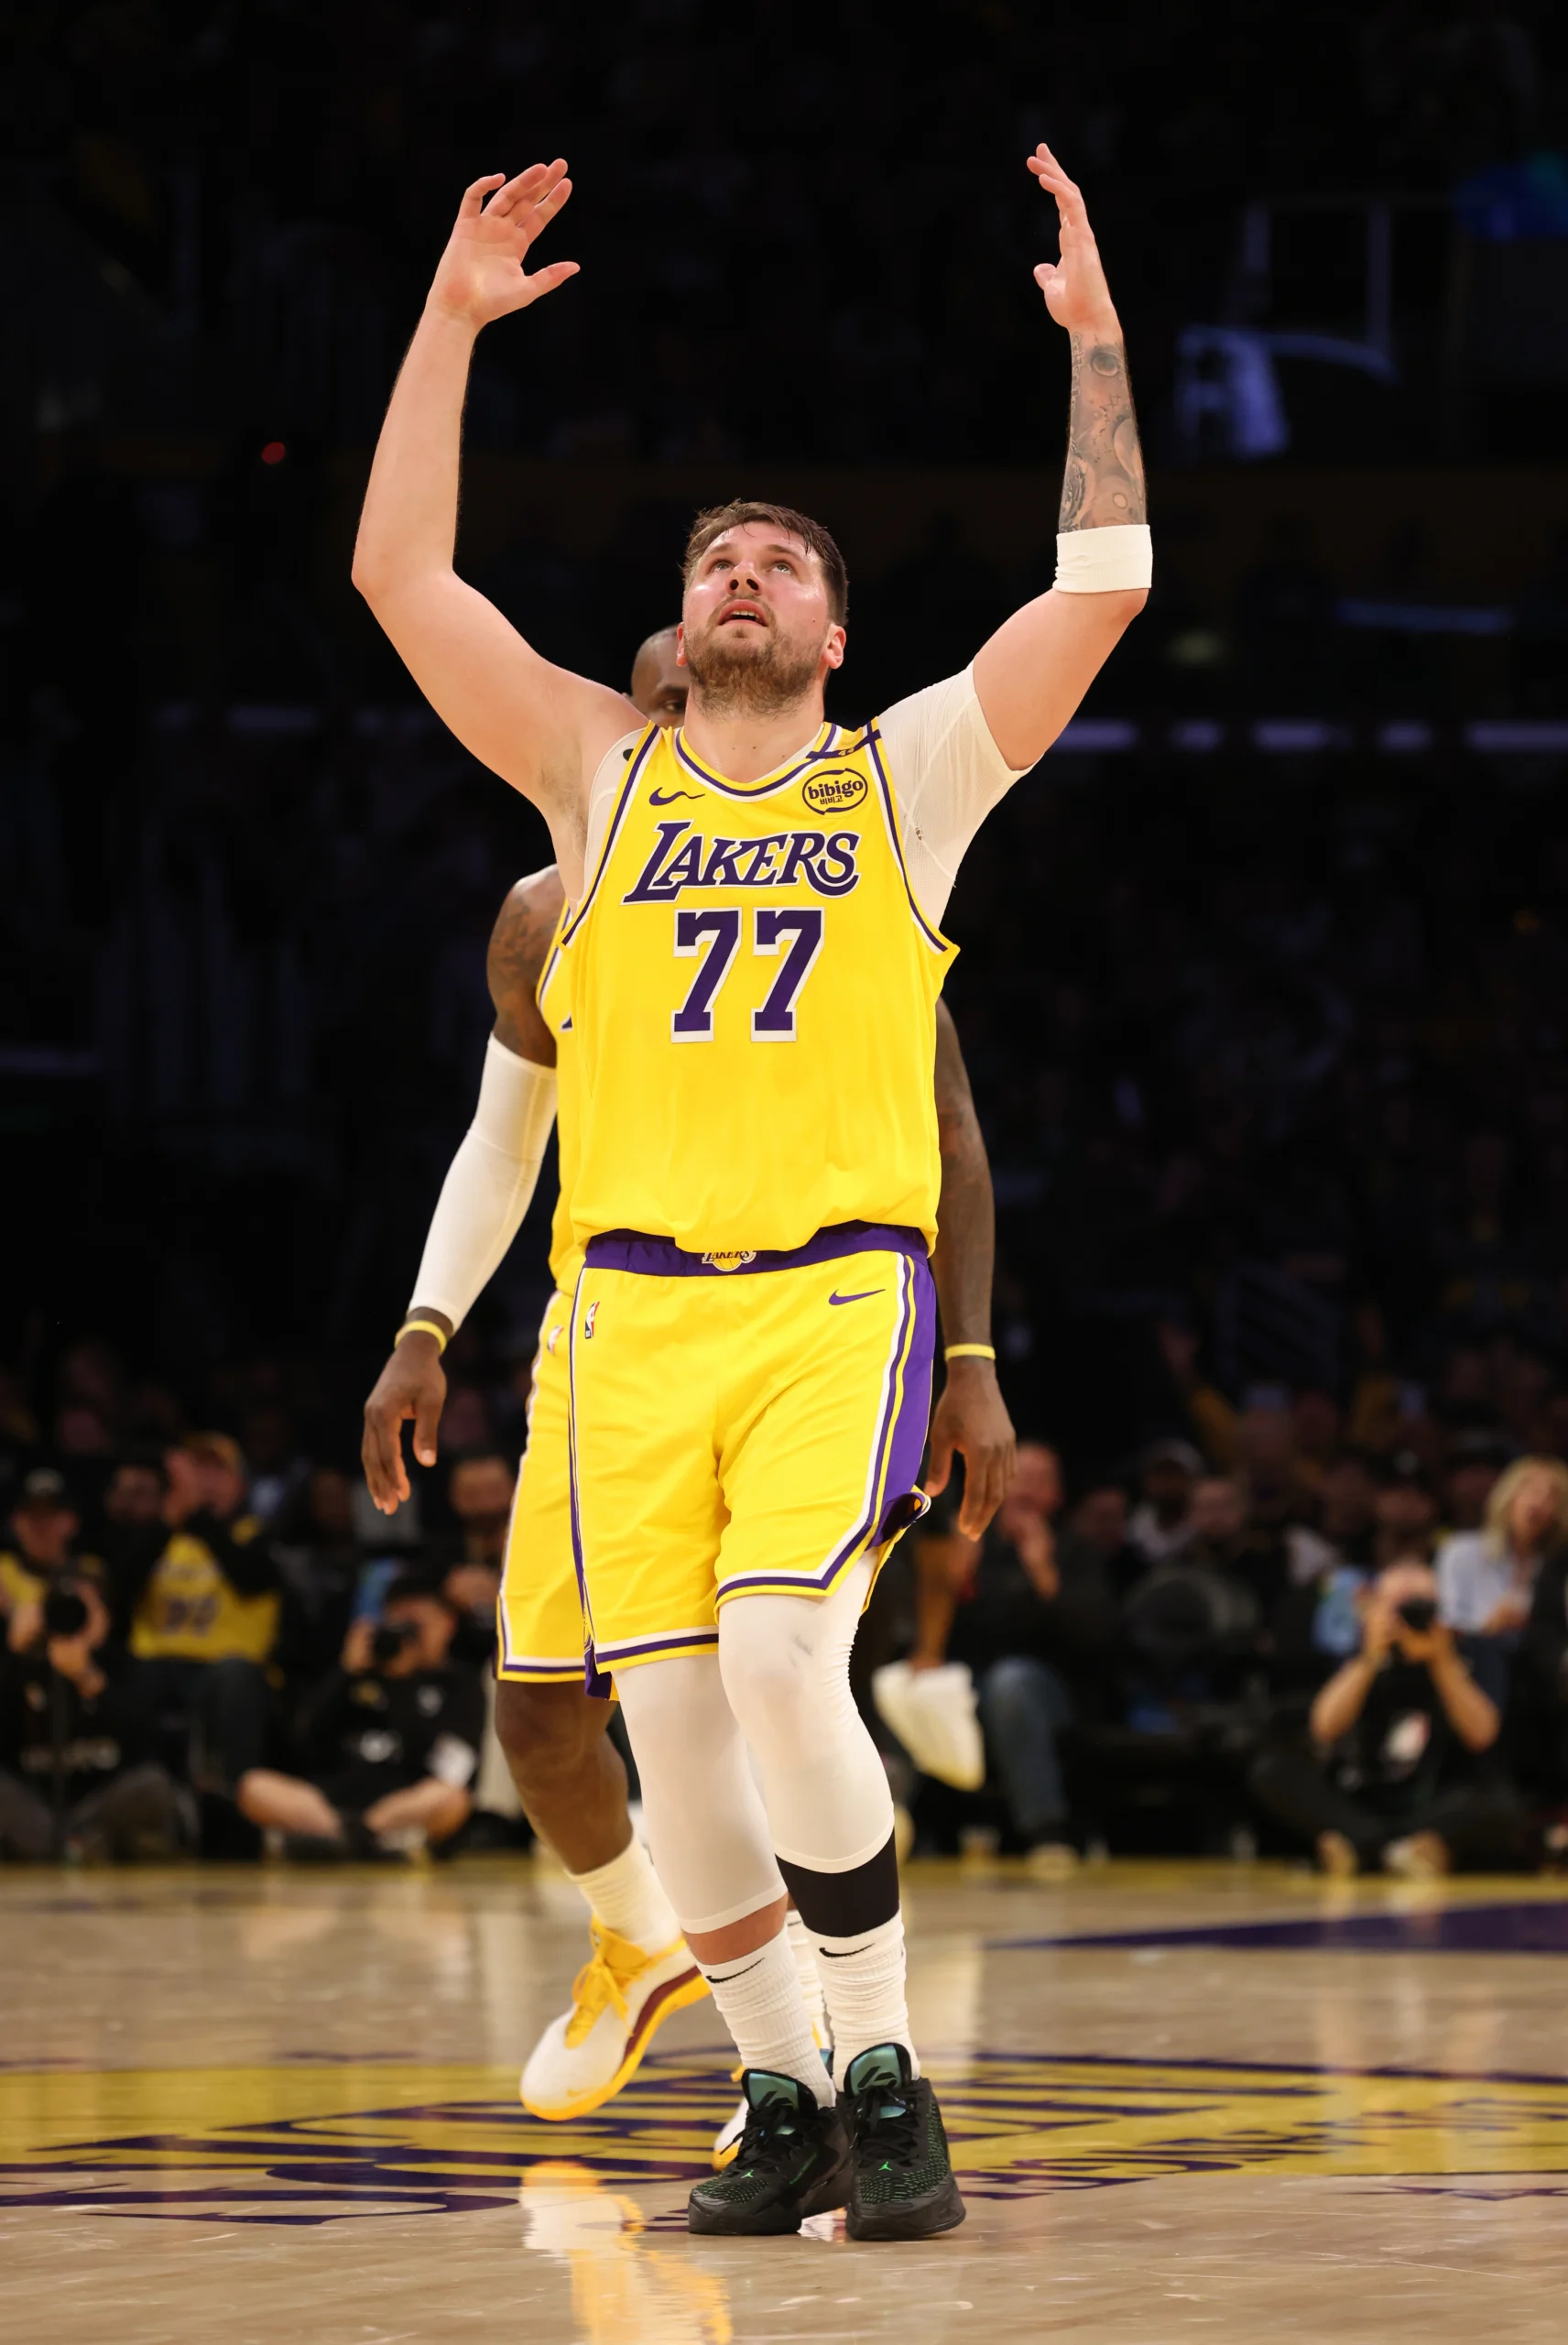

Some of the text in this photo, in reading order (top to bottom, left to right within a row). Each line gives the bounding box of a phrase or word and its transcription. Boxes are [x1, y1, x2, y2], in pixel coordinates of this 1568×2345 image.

[808, 780, 864, 800] bibigo
[820, 795, 843, 805] 비비고
[620, 819, 862, 906] LAKERS
[671, 907, 824, 1043] 77
